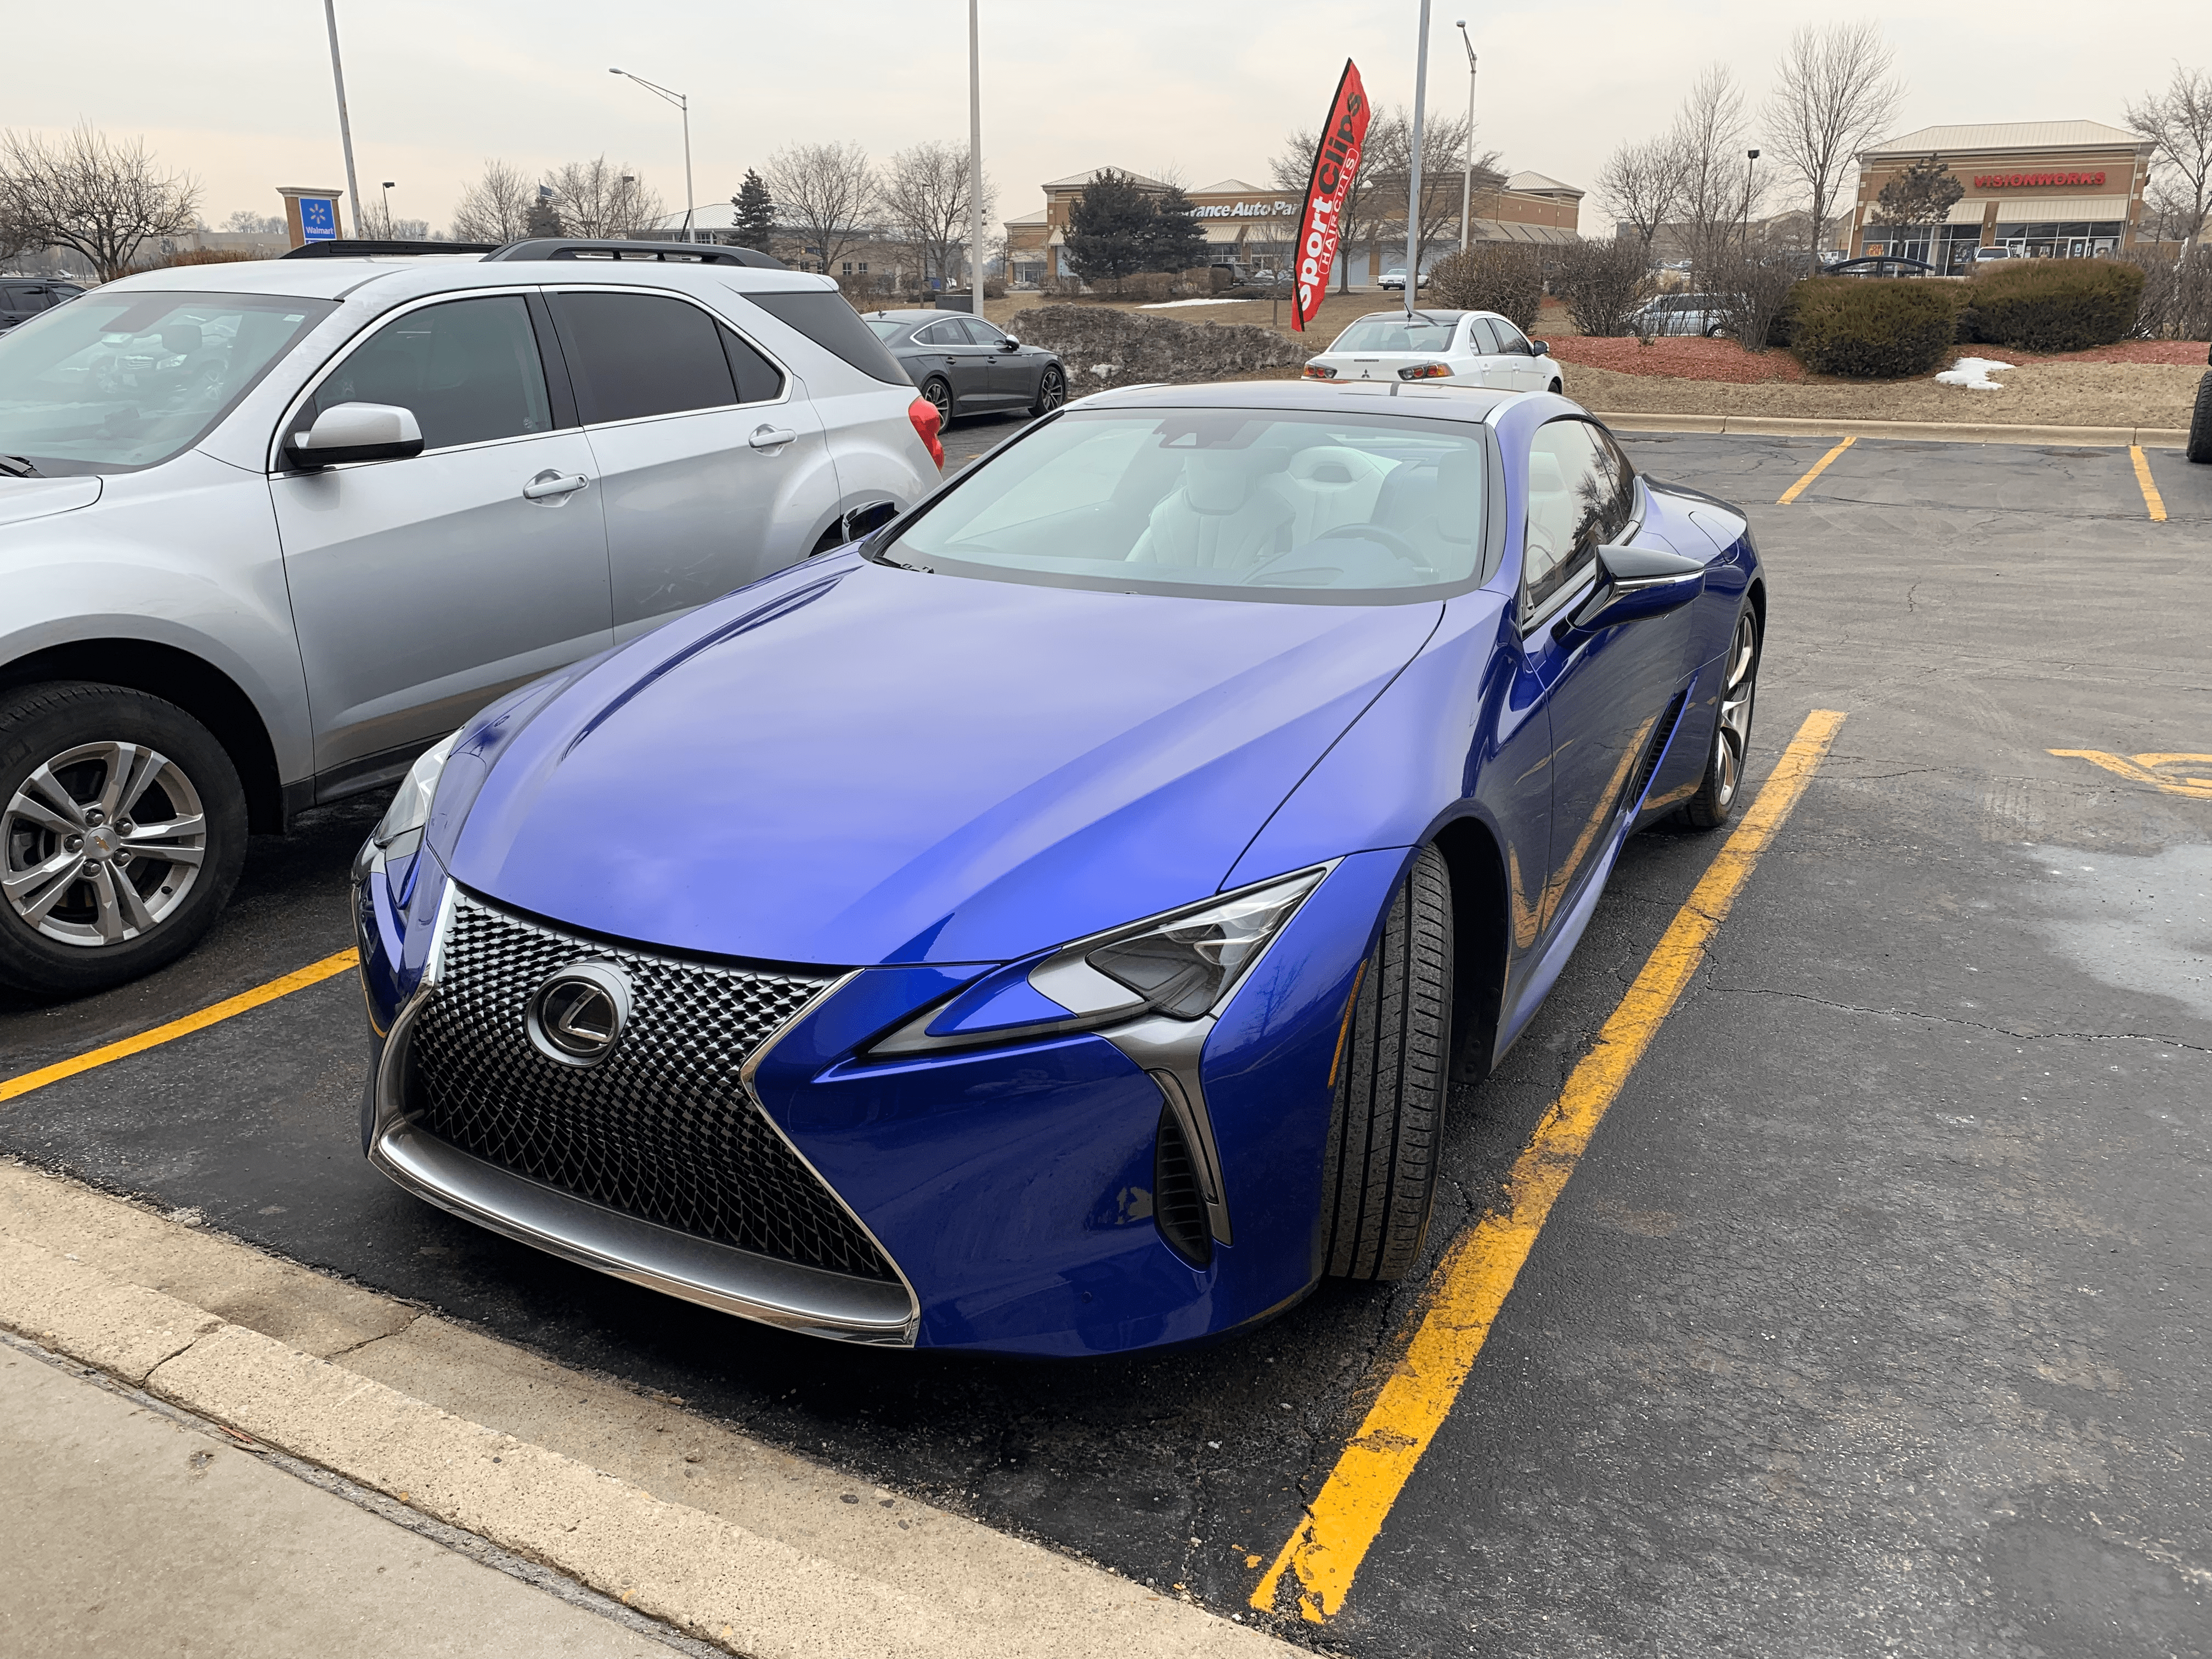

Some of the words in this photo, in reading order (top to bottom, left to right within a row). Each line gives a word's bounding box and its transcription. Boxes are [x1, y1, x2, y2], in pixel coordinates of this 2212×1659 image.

[1974, 172, 2106, 188] VISIONWORKS
[1177, 206, 1231, 217] vance
[1231, 201, 1271, 217] Auto
[1271, 201, 1304, 216] Par
[1299, 196, 1333, 312] Sport
[1318, 92, 1362, 195] Clips
[1322, 157, 1355, 265] HAIRCUTS
[306, 226, 334, 234] Walmart
